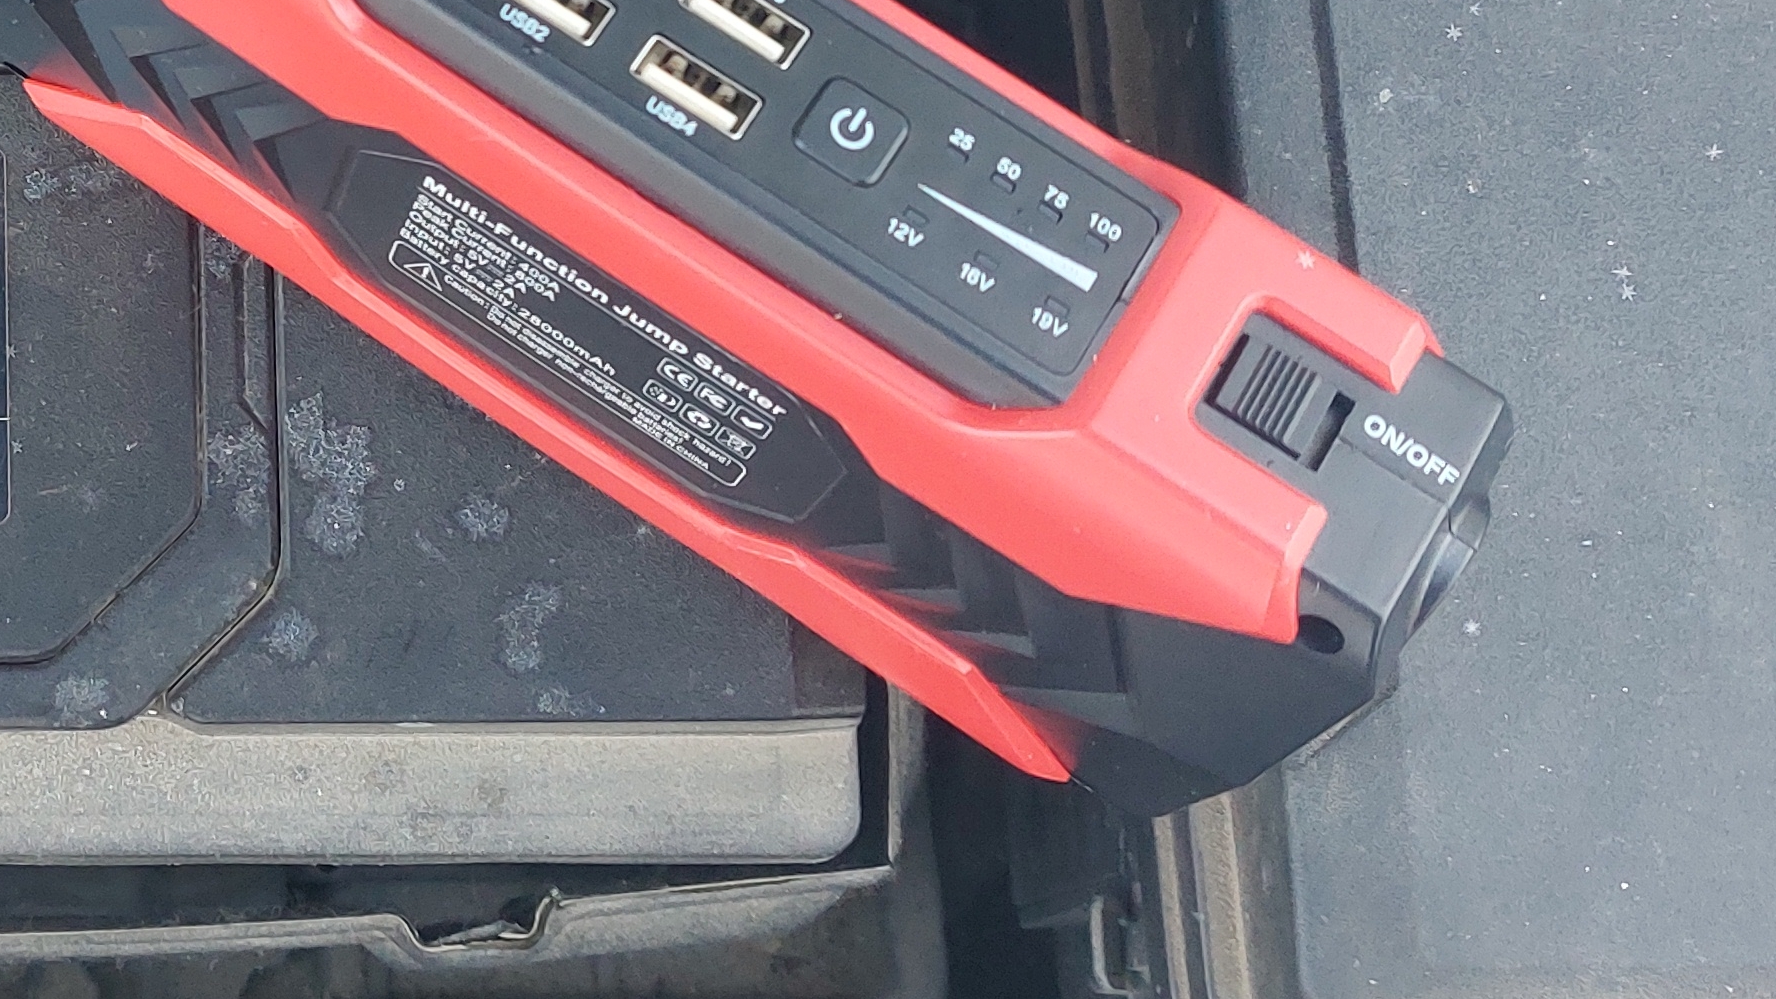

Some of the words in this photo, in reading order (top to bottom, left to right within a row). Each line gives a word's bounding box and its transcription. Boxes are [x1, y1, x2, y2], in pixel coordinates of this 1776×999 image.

[499, 4, 551, 43] USB2
[645, 95, 698, 136] USB4
[948, 127, 976, 151] 25
[996, 157, 1022, 181] 50
[1044, 184, 1069, 209] 75
[400, 227, 450, 264] Battery
[416, 194, 453, 224] Start
[518, 263, 560, 293] 400A
[887, 217, 924, 247] 12V
[1089, 212, 1122, 242] 100
[412, 200, 451, 231] Peak
[512, 270, 557, 301] 800A
[423, 176, 608, 303] Multi-Function
[609, 305, 688, 361] Jump
[693, 353, 786, 414] Starter
[1030, 307, 1069, 338] 19V
[1364, 414, 1460, 485] ON/OFF
